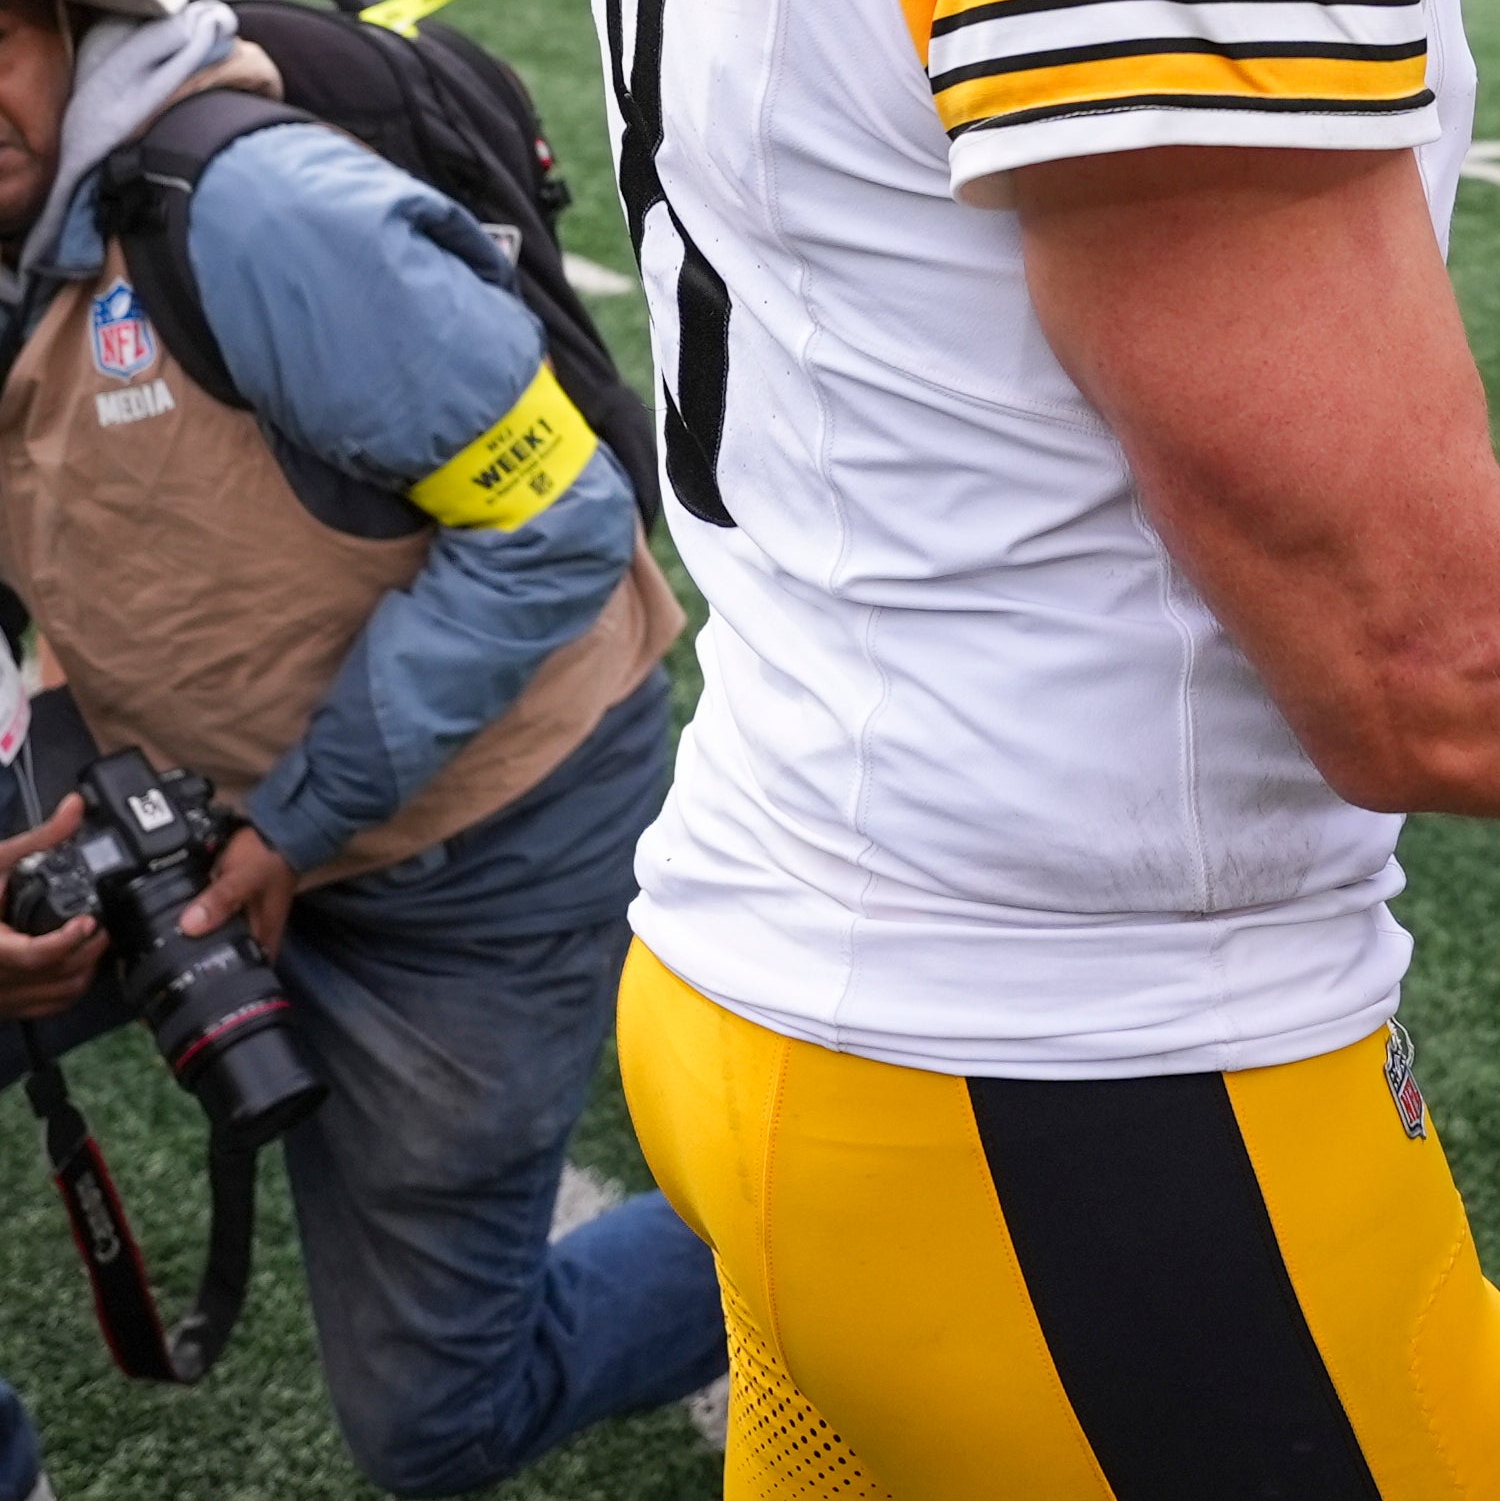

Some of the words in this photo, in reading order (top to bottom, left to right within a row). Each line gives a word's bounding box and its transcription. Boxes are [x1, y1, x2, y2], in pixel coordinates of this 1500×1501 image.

[100, 319, 149, 367] NFL
[95, 377, 176, 428] MEDIA
[470, 425, 545, 490] WEEK
